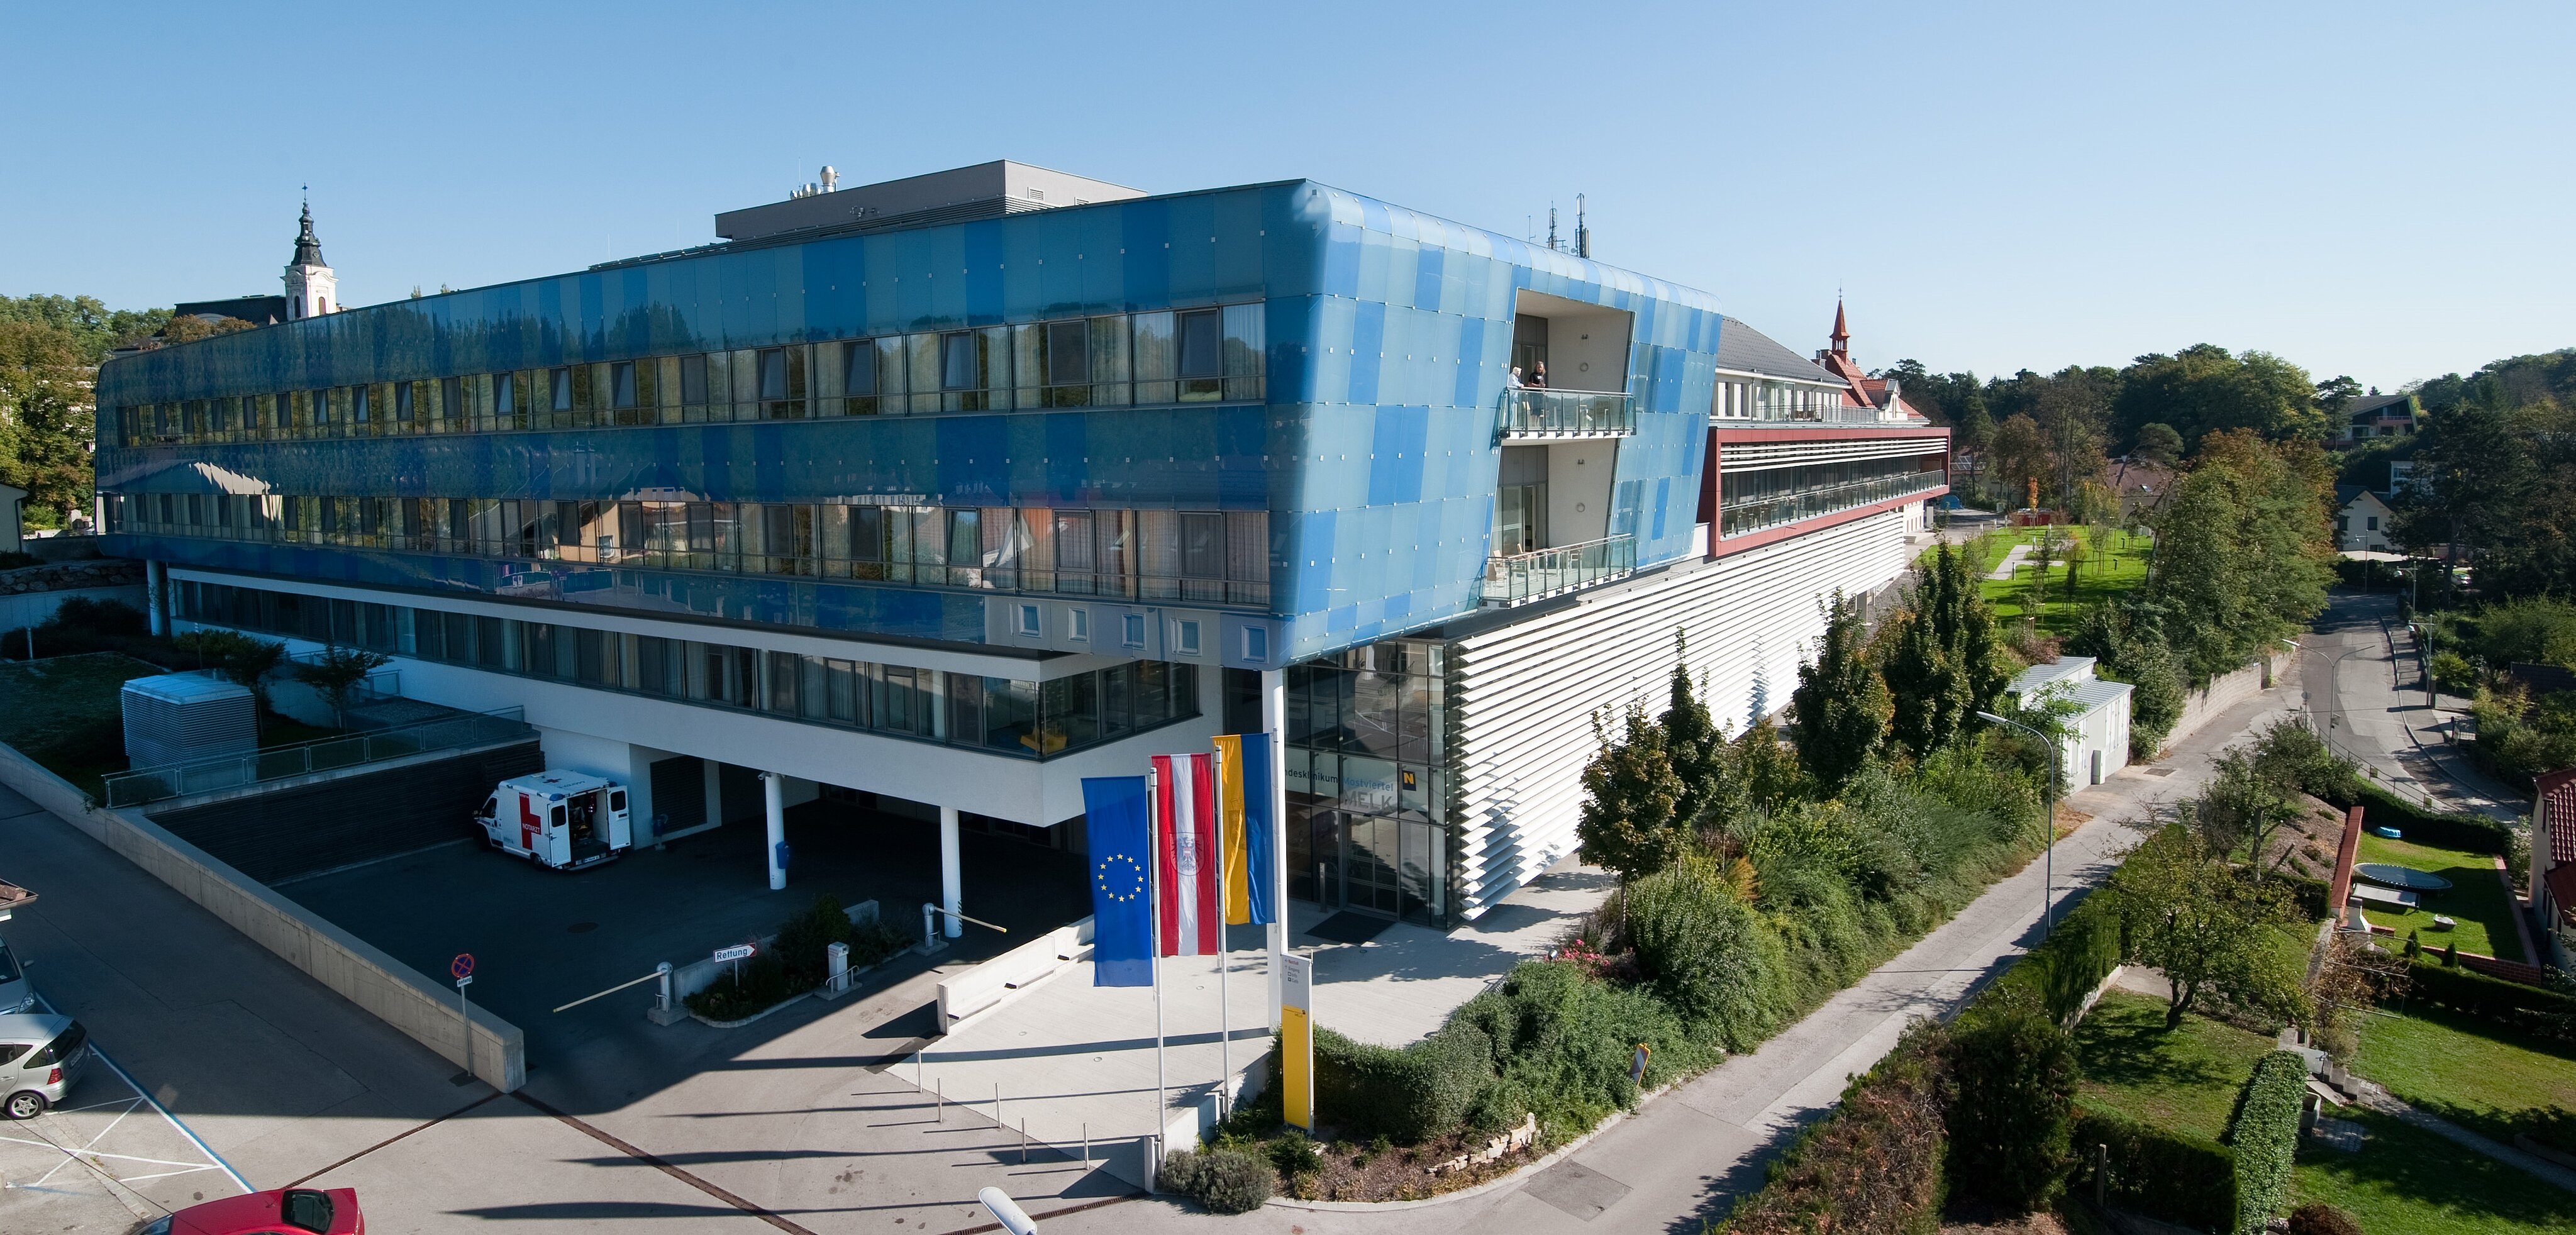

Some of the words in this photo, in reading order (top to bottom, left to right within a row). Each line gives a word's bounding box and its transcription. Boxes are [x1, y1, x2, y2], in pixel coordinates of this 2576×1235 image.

[1285, 768, 1338, 784] ndesklnikum
[1343, 777, 1393, 791] Mostviertel
[1343, 790, 1393, 812] MELK
[522, 822, 540, 834] NOTARZT
[717, 949, 747, 960] Rettung
